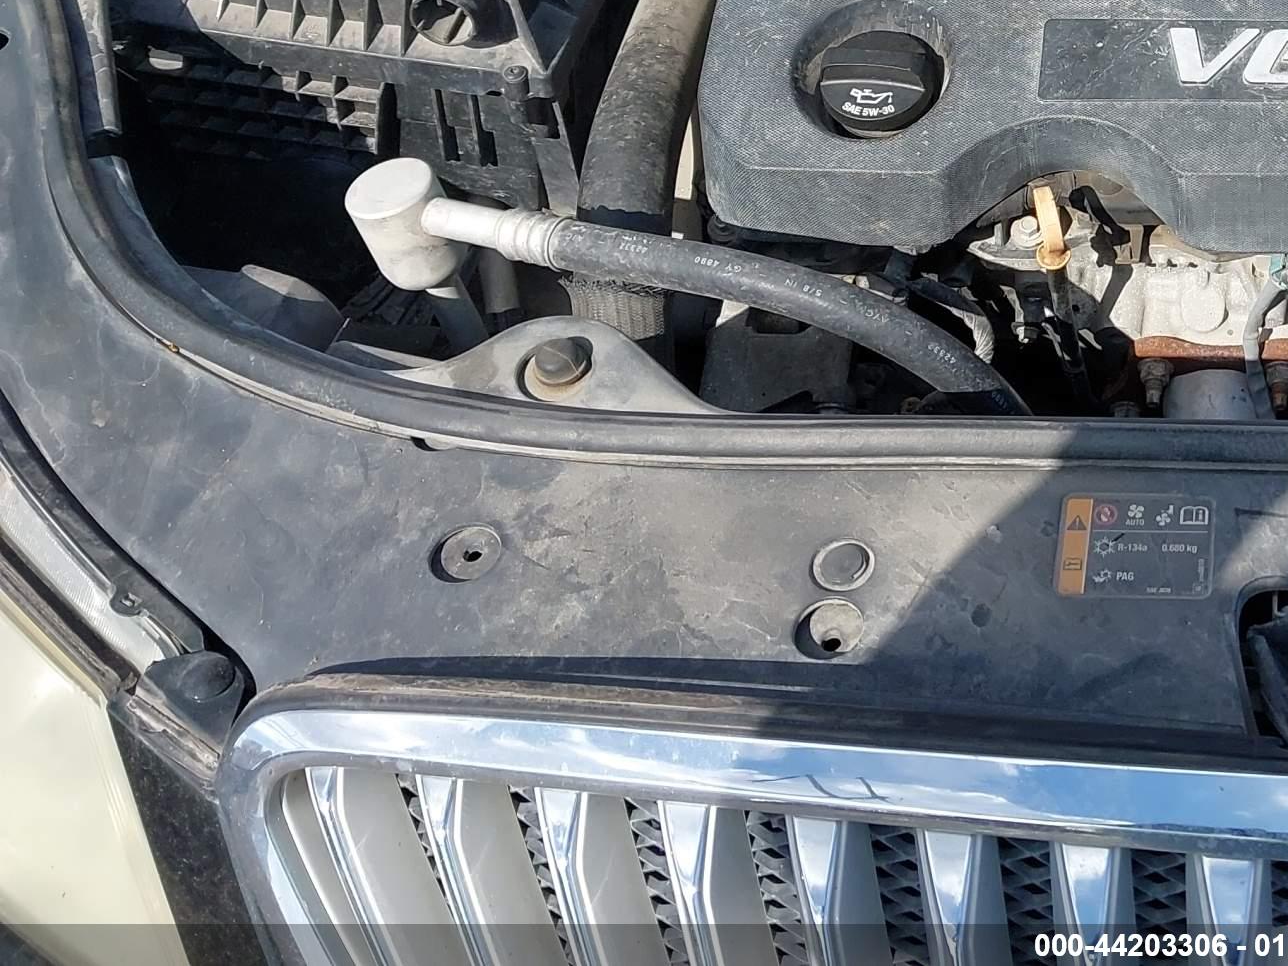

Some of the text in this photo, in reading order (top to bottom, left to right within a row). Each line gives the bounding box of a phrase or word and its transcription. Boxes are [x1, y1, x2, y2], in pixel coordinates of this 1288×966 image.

[842, 102, 895, 116] SAE 5W-30
[1125, 518, 1145, 526] AUTO
[1186, 543, 1198, 554] kg
[1116, 571, 1135, 582] PAG
